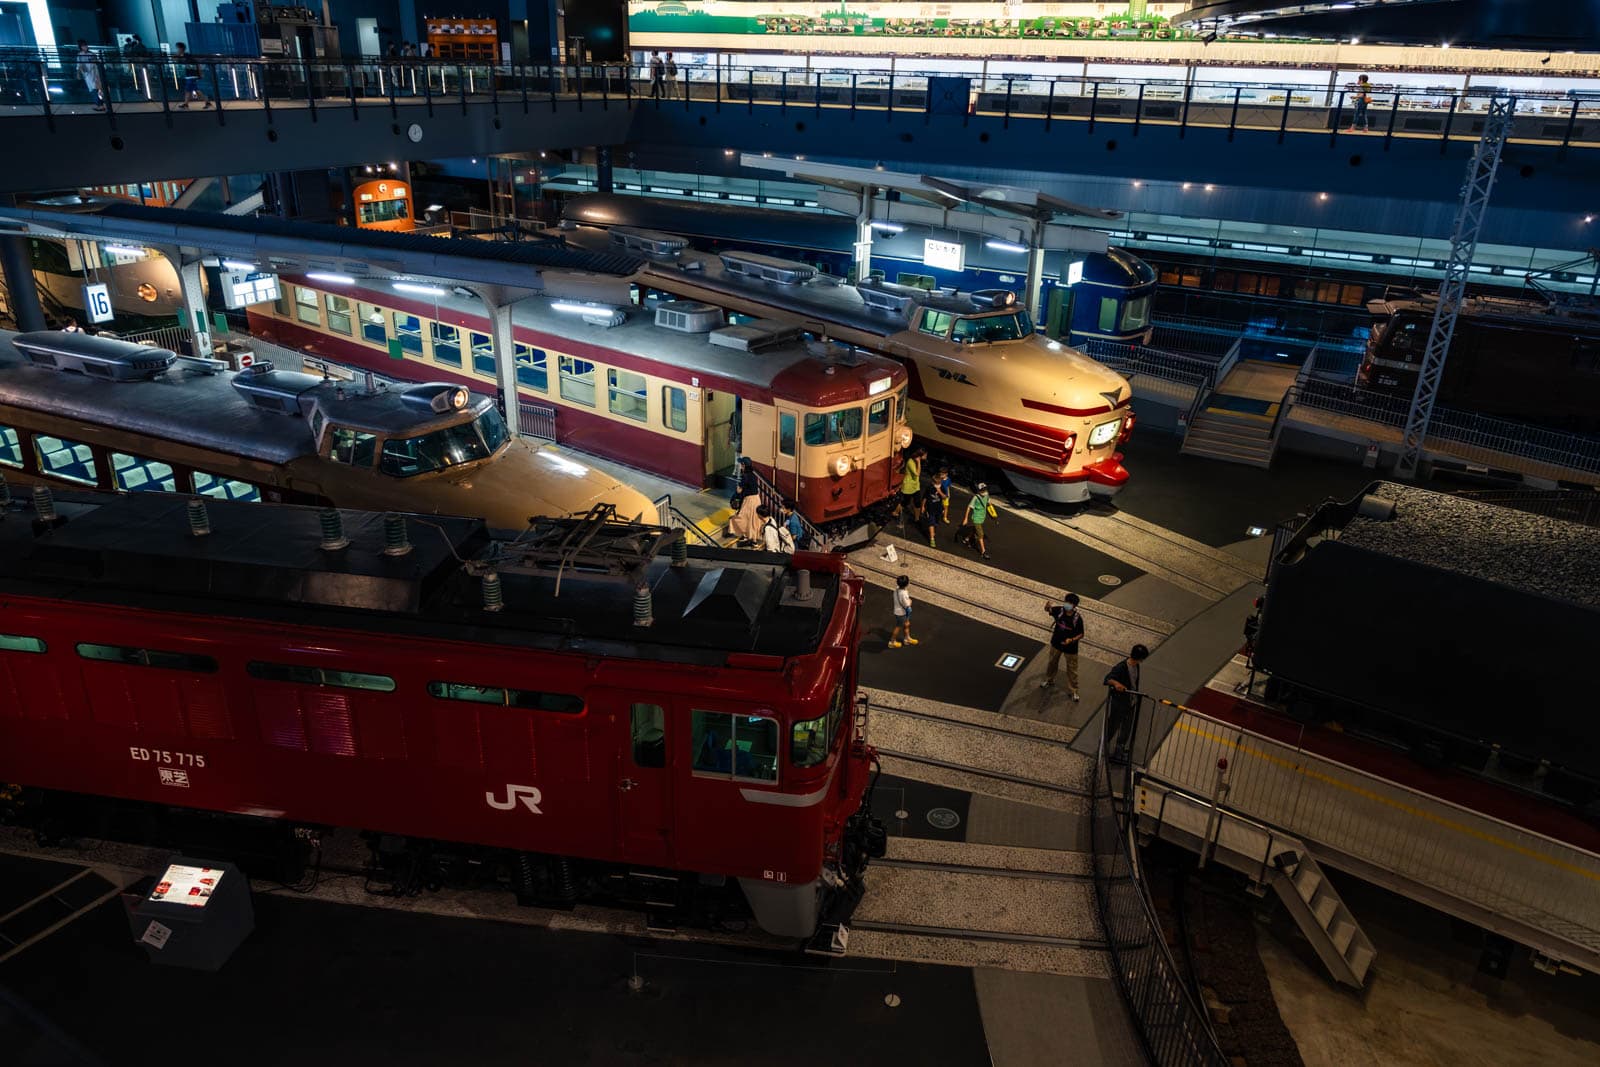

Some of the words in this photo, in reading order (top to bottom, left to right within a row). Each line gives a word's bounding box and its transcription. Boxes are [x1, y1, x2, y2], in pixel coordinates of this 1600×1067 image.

[231, 275, 241, 285] 16
[91, 292, 109, 316] 16
[129, 746, 150, 761] ED
[152, 749, 172, 764] 75
[175, 752, 205, 768] 775
[159, 768, 188, 785] 東芝
[485, 783, 544, 815] JR
